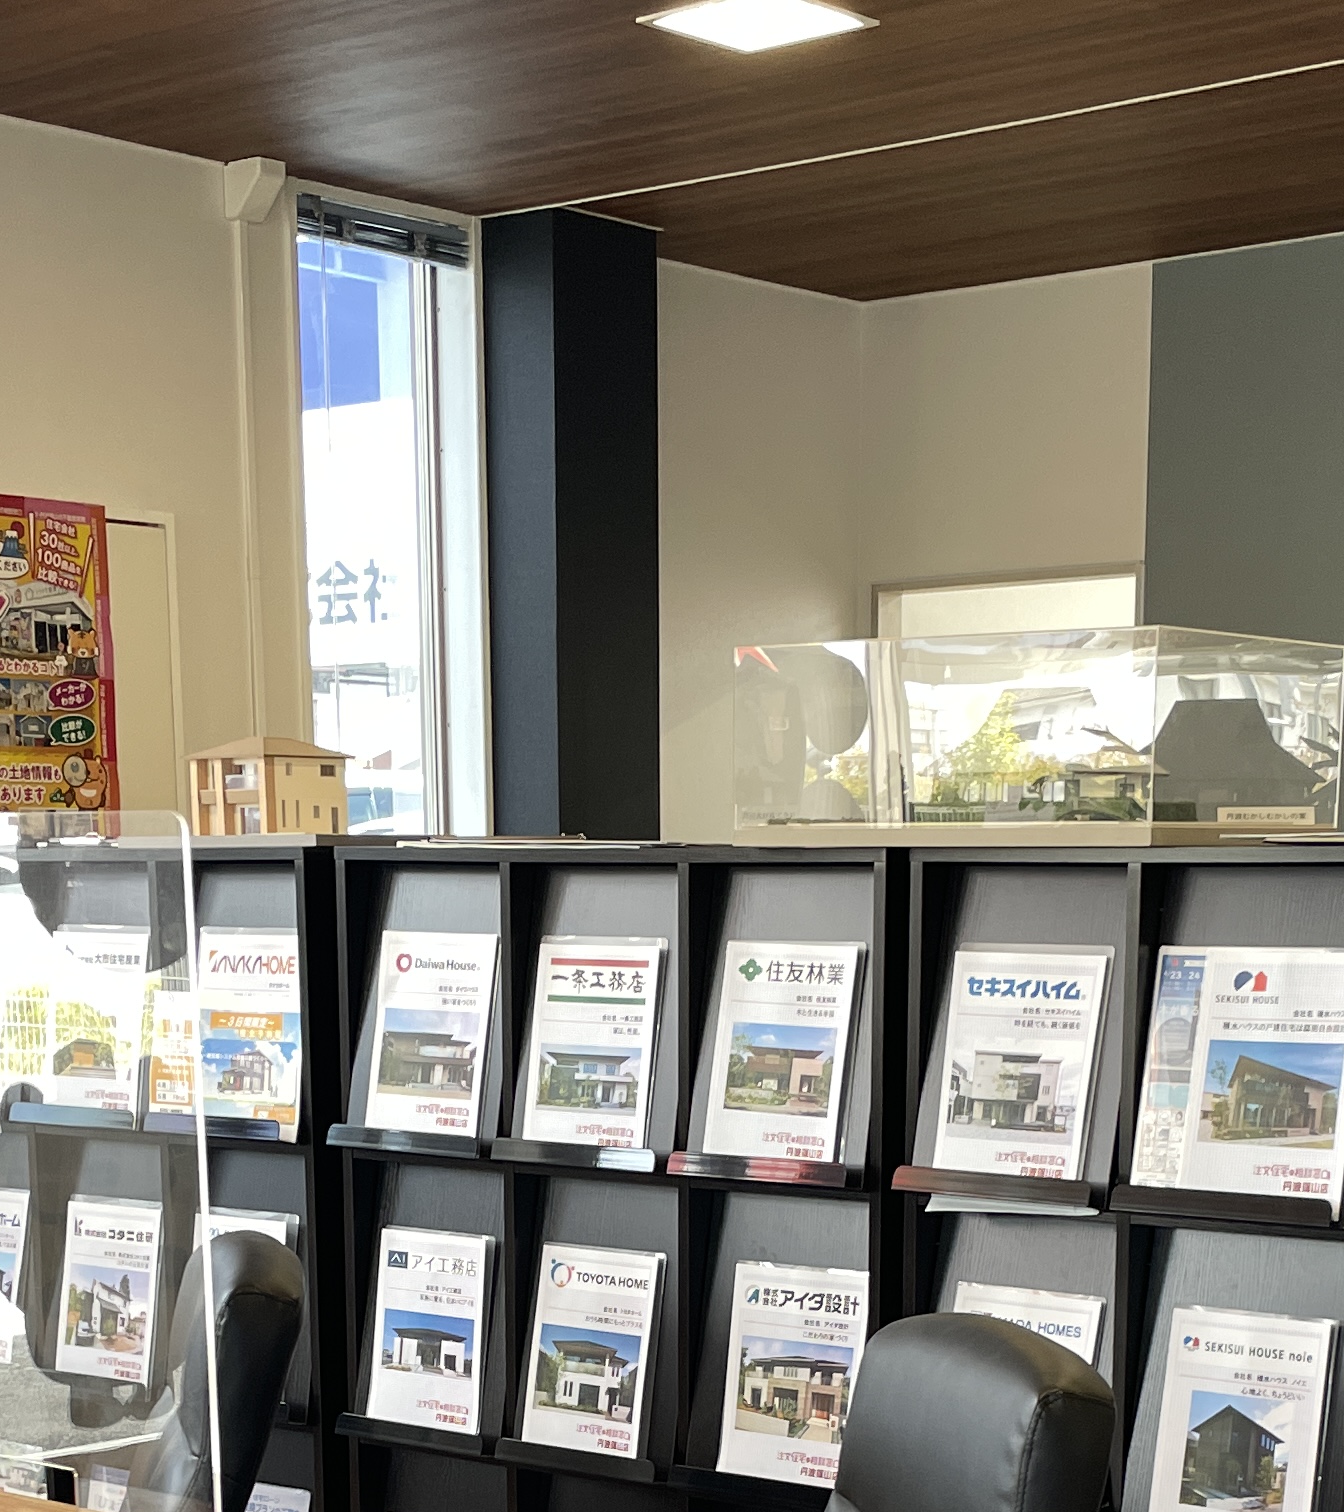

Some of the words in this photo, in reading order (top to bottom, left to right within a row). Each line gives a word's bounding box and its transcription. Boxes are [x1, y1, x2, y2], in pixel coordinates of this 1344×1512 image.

[415, 957, 445, 970] Daiwa
[447, 959, 477, 971] House
[765, 959, 846, 985] 住友林業
[551, 968, 646, 994] 一条工務店
[967, 976, 1081, 1000] セキスイハイム
[1215, 994, 1250, 1004] SEKISUI
[1252, 995, 1280, 1005] HOUSE
[411, 1254, 477, 1277] アイ工務店
[576, 1271, 616, 1287] TOYOTA
[617, 1275, 649, 1290] HOME
[778, 1289, 860, 1317] アイダ設計
[1204, 1340, 1244, 1356] SEKISUI
[1248, 1346, 1284, 1360] HOUSE
[1288, 1352, 1313, 1363] noie
